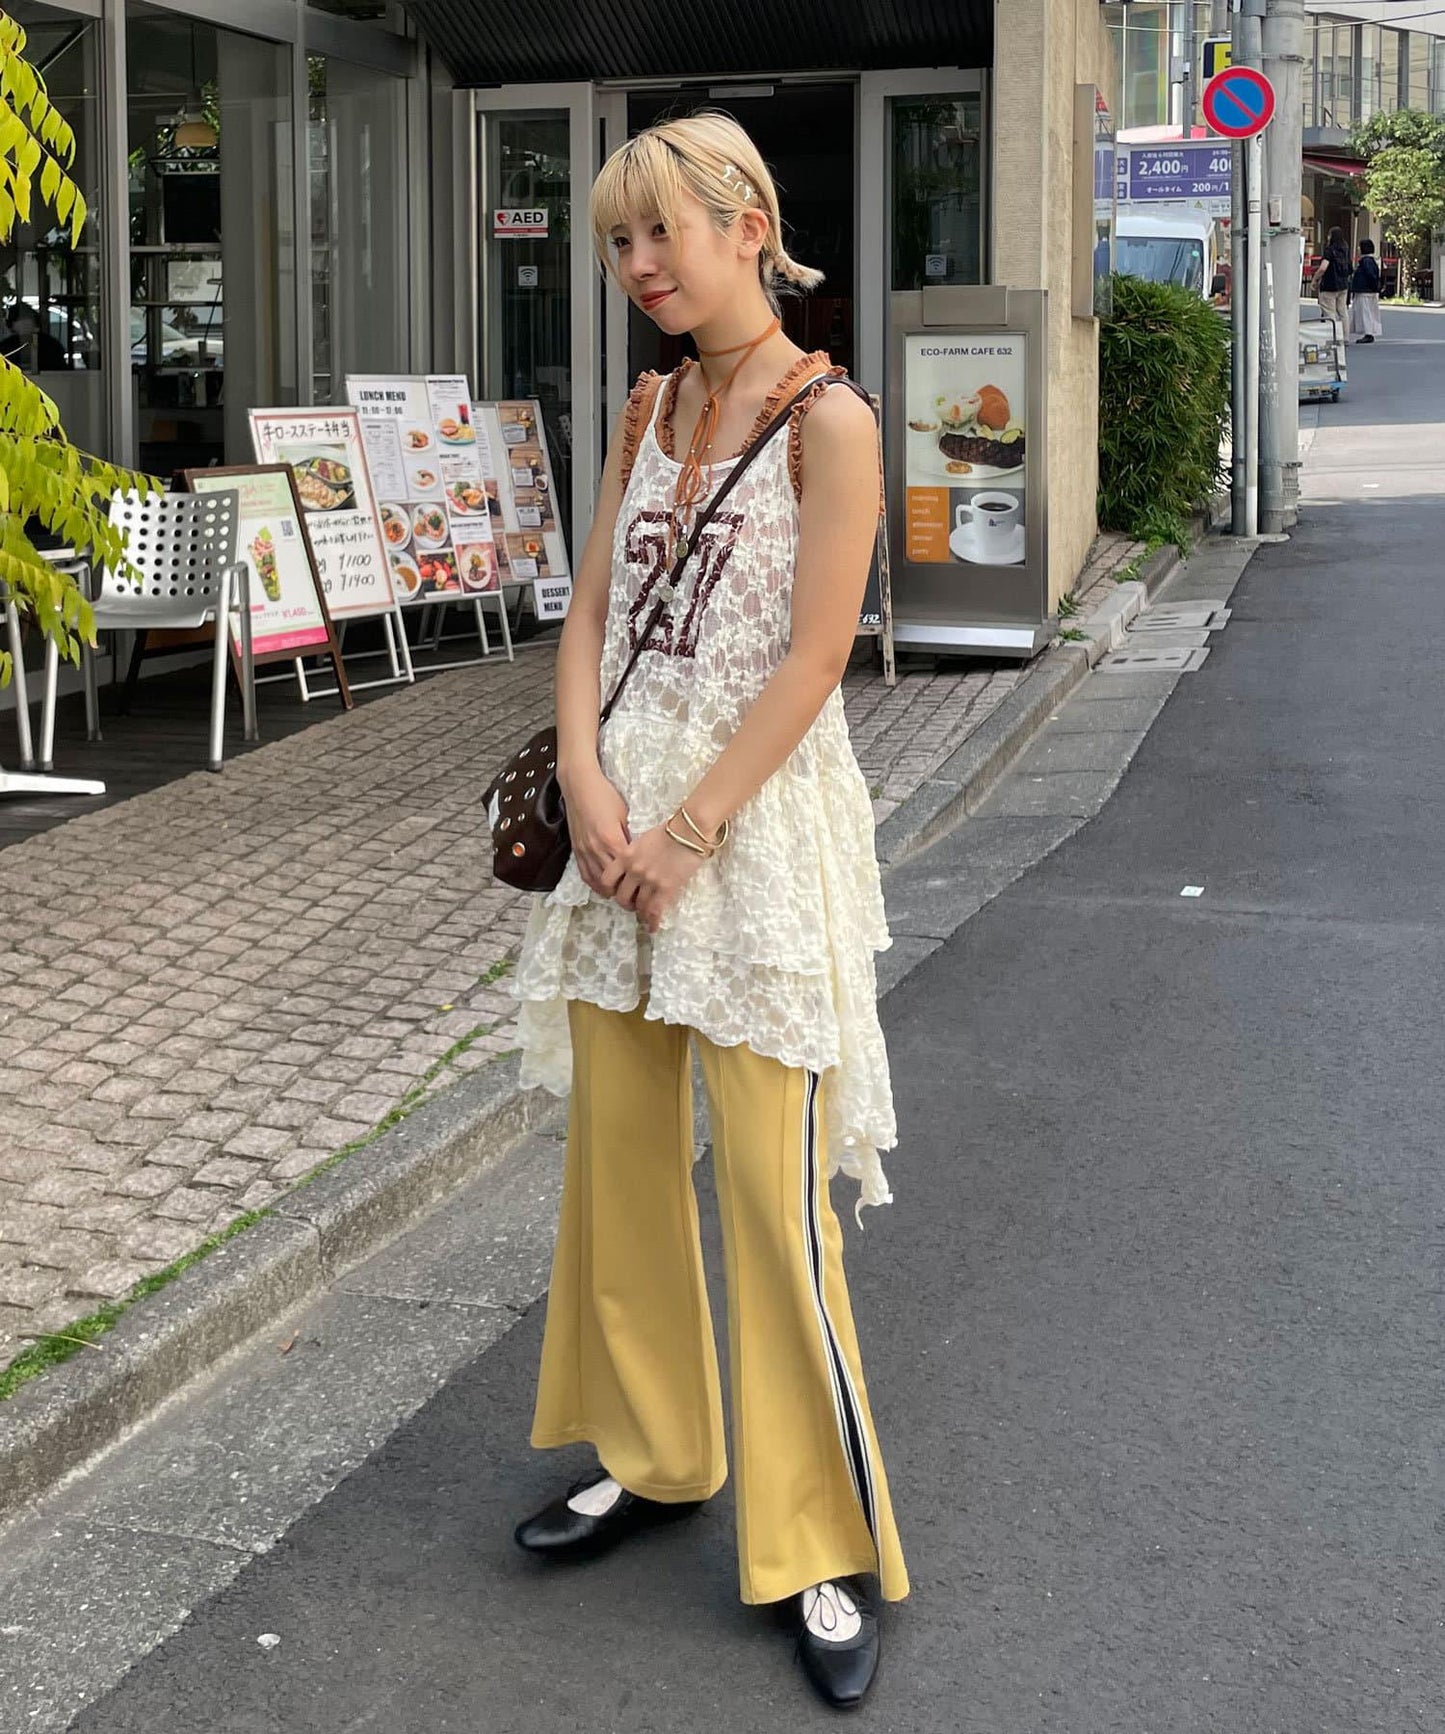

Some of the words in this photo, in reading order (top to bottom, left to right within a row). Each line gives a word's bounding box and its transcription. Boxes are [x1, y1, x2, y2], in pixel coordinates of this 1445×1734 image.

[512, 211, 544, 224] AED
[920, 348, 969, 356] ECO-FARM
[971, 347, 996, 356] CAFE
[996, 347, 1013, 355] 632
[360, 390, 385, 401] LUNCH
[385, 391, 407, 401] MENU
[541, 586, 570, 598] DESSERT
[544, 601, 563, 612] MENU
